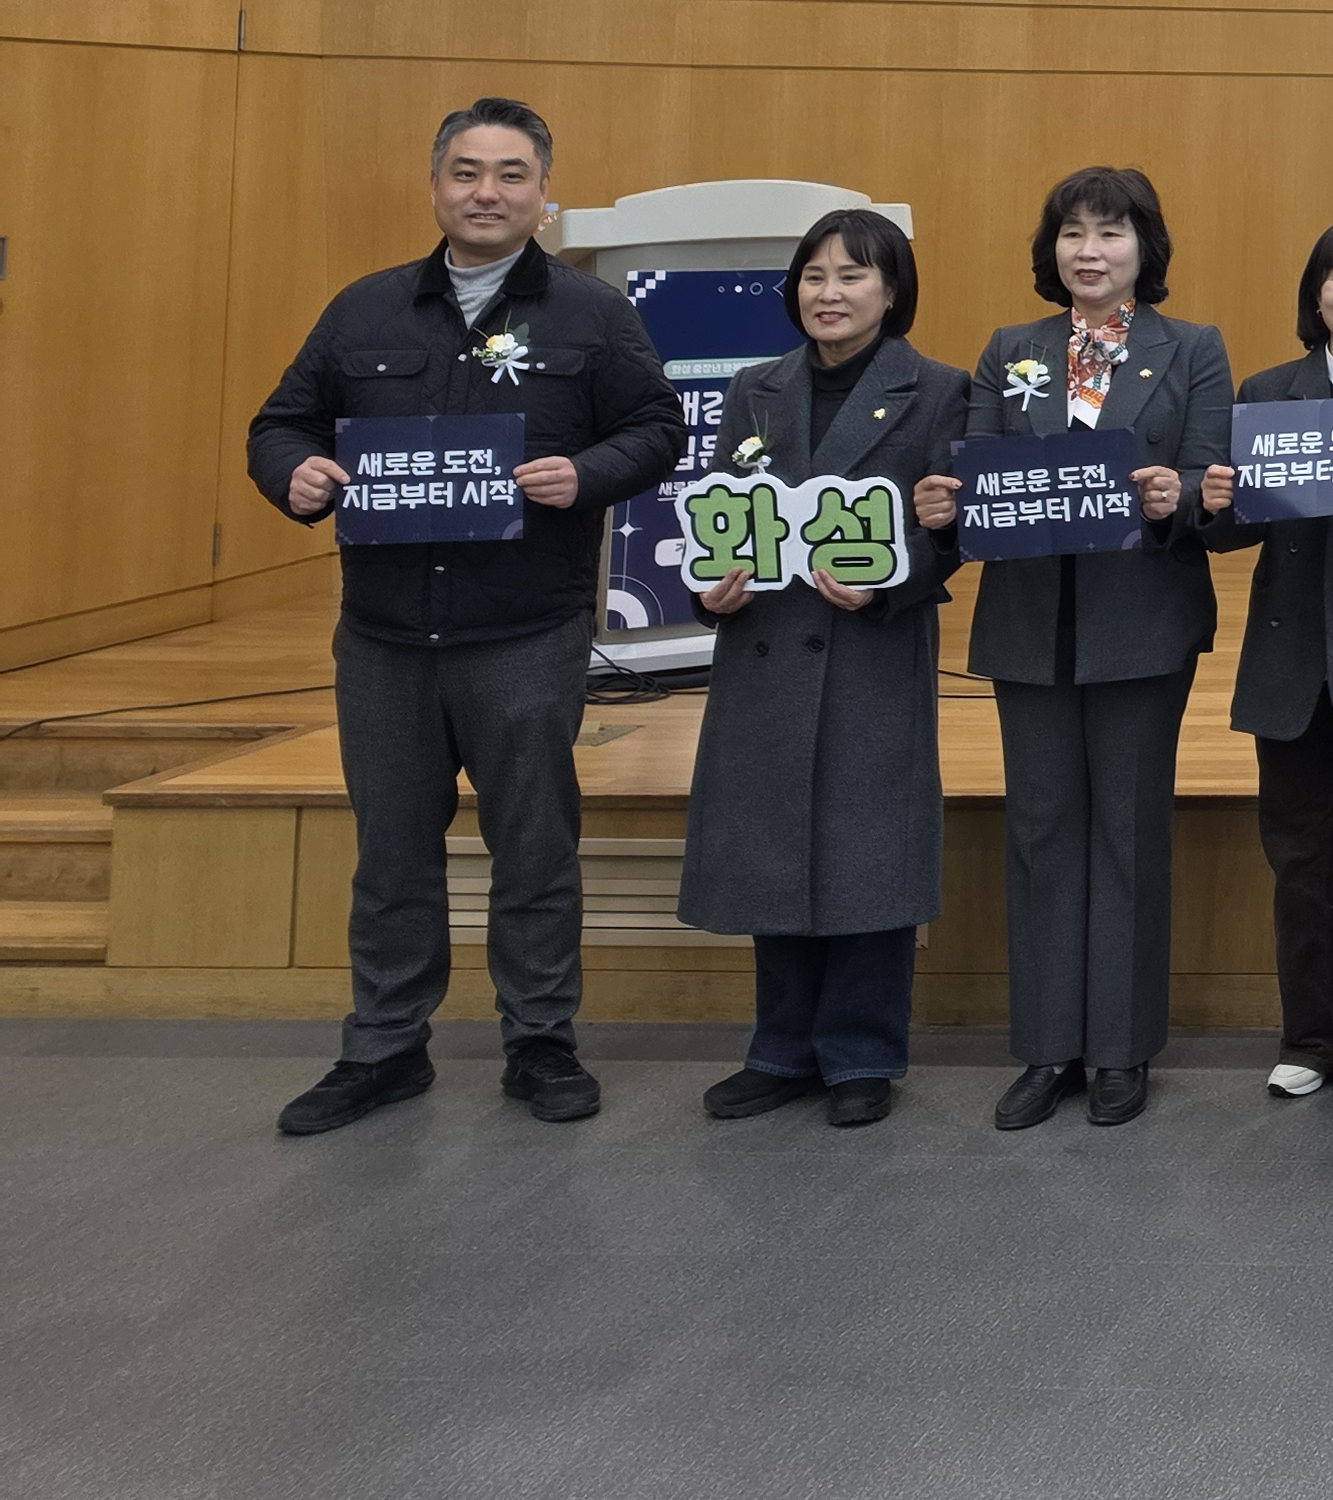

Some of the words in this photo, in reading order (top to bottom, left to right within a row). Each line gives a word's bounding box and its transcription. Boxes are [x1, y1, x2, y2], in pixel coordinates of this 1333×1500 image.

[1250, 430, 1324, 457] 새로운
[356, 450, 436, 477] 새로운
[441, 448, 502, 475] 도전,
[342, 481, 453, 511] 지금부터
[461, 479, 518, 507] 시작
[975, 467, 1051, 496] 새로운
[1056, 463, 1116, 490] 도전,
[962, 496, 1072, 529] 지금부터
[1078, 491, 1133, 520] 시작
[685, 483, 898, 583] 화성
